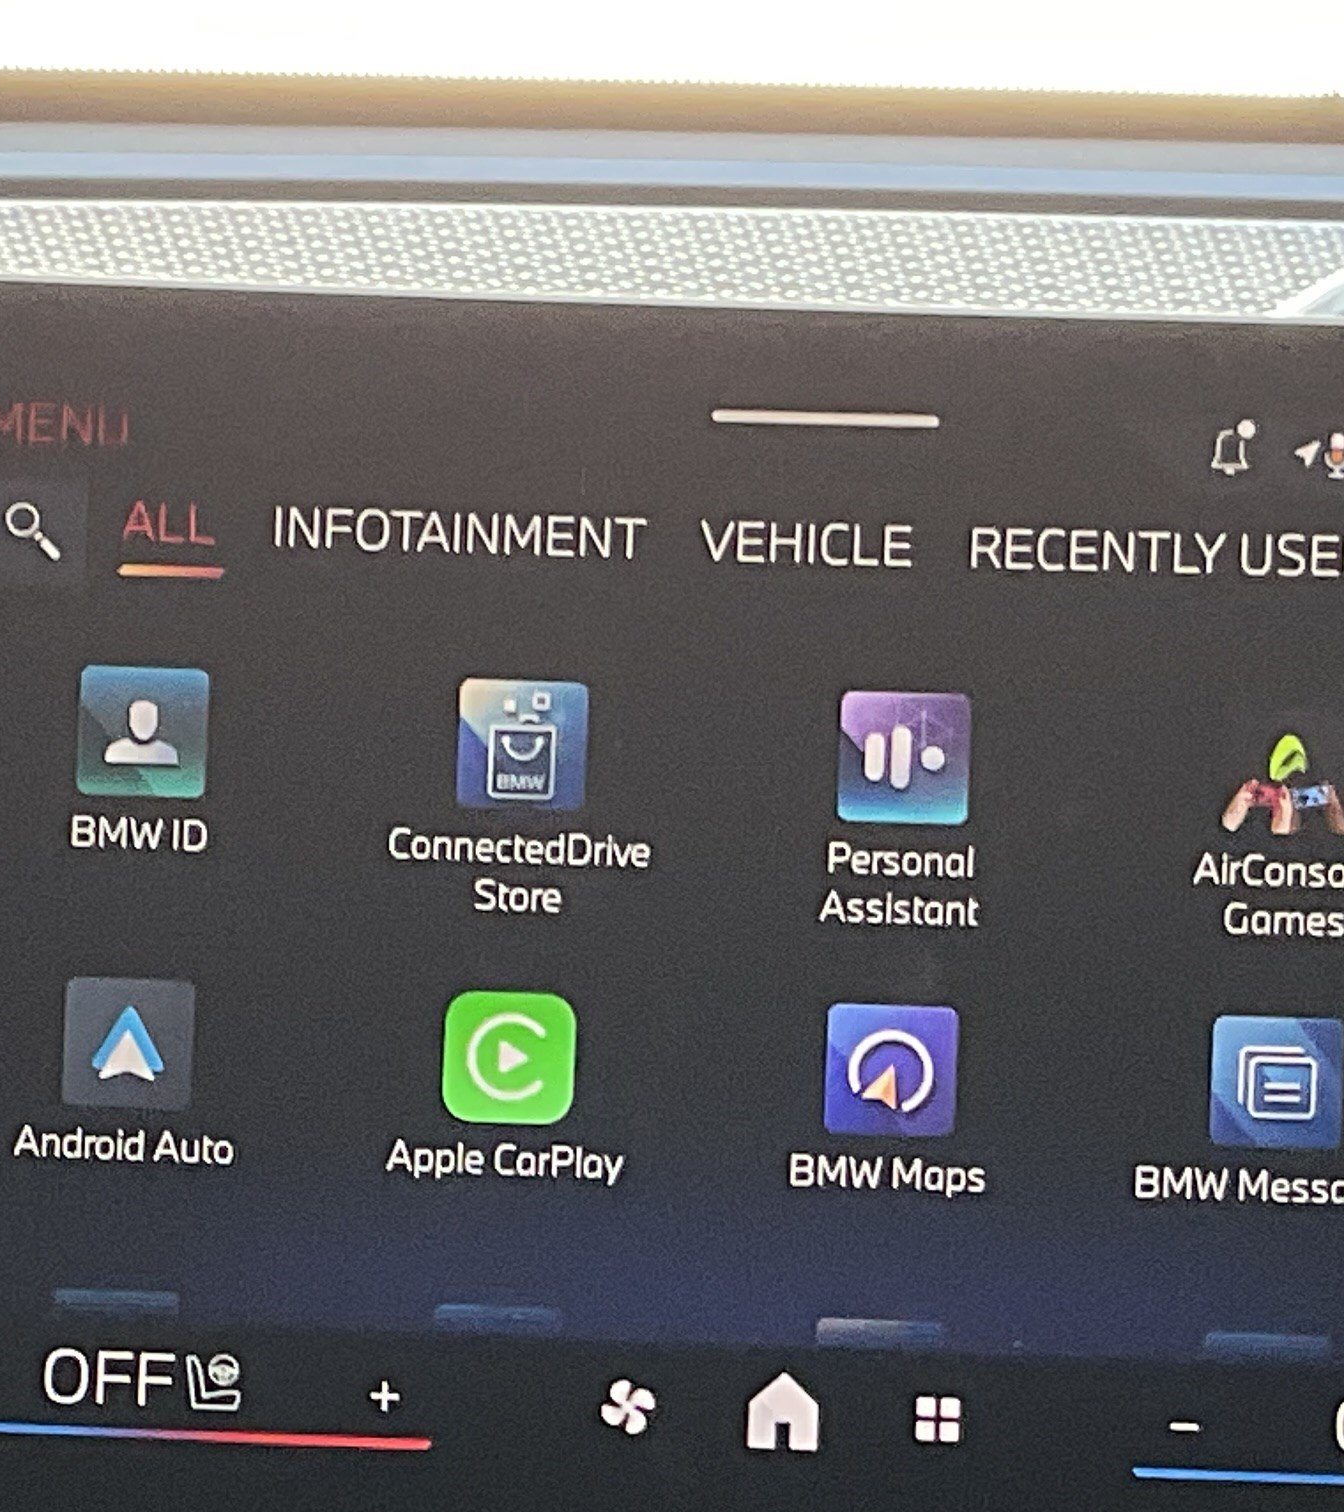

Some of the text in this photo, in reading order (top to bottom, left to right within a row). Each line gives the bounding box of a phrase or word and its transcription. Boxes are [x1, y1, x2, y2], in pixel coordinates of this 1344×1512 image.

[122, 499, 214, 545] ALL
[274, 506, 648, 559] INFOTAINMENT
[701, 519, 913, 568] VEHICLE
[970, 526, 1227, 574] RECENTLY
[71, 814, 208, 852] BMW ID
[388, 826, 651, 868] ConnectedDrive
[827, 840, 975, 878] Personal
[474, 877, 562, 914] Store
[819, 889, 980, 927] Assistant
[1223, 901, 1344, 937] Games
[13, 1124, 234, 1165] Android Auto
[385, 1138, 624, 1186] Apple CarPlay
[789, 1153, 986, 1198] BMW Maps
[1134, 1165, 1229, 1201] BMW
[44, 1347, 176, 1407] OFF
